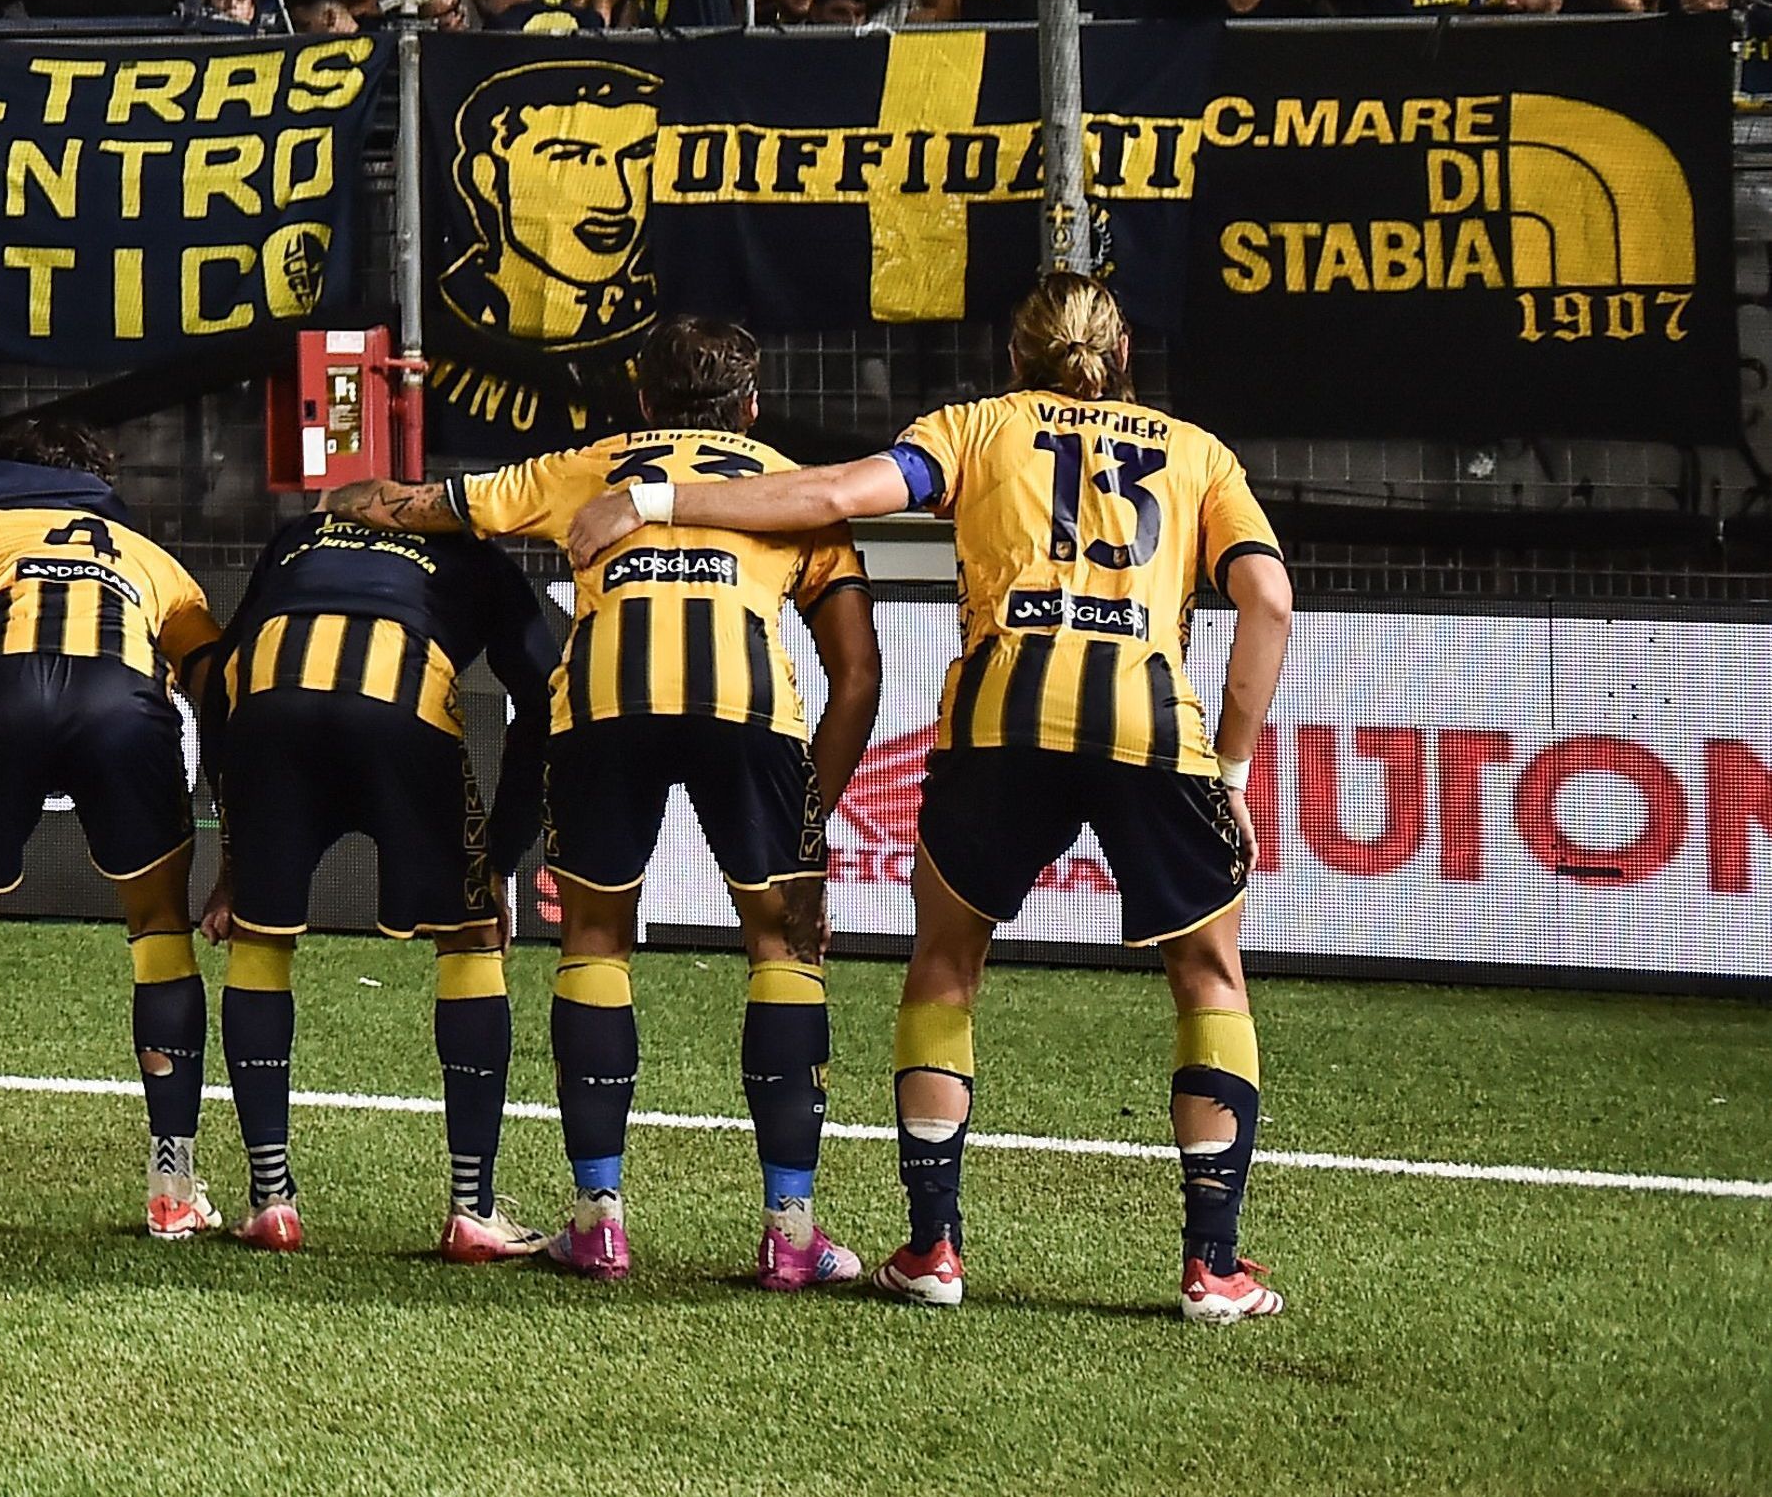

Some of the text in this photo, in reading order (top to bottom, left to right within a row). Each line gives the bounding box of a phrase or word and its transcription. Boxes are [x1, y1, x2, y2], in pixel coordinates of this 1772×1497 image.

[1202, 95, 1502, 148] C.MARE
[1426, 149, 1502, 214] DI
[1218, 218, 1506, 295] STABIA
[1515, 290, 1694, 343] 1907
[1038, 400, 1169, 443] VARNIER
[1034, 430, 1169, 571] 13
[45, 516, 123, 565] 4
